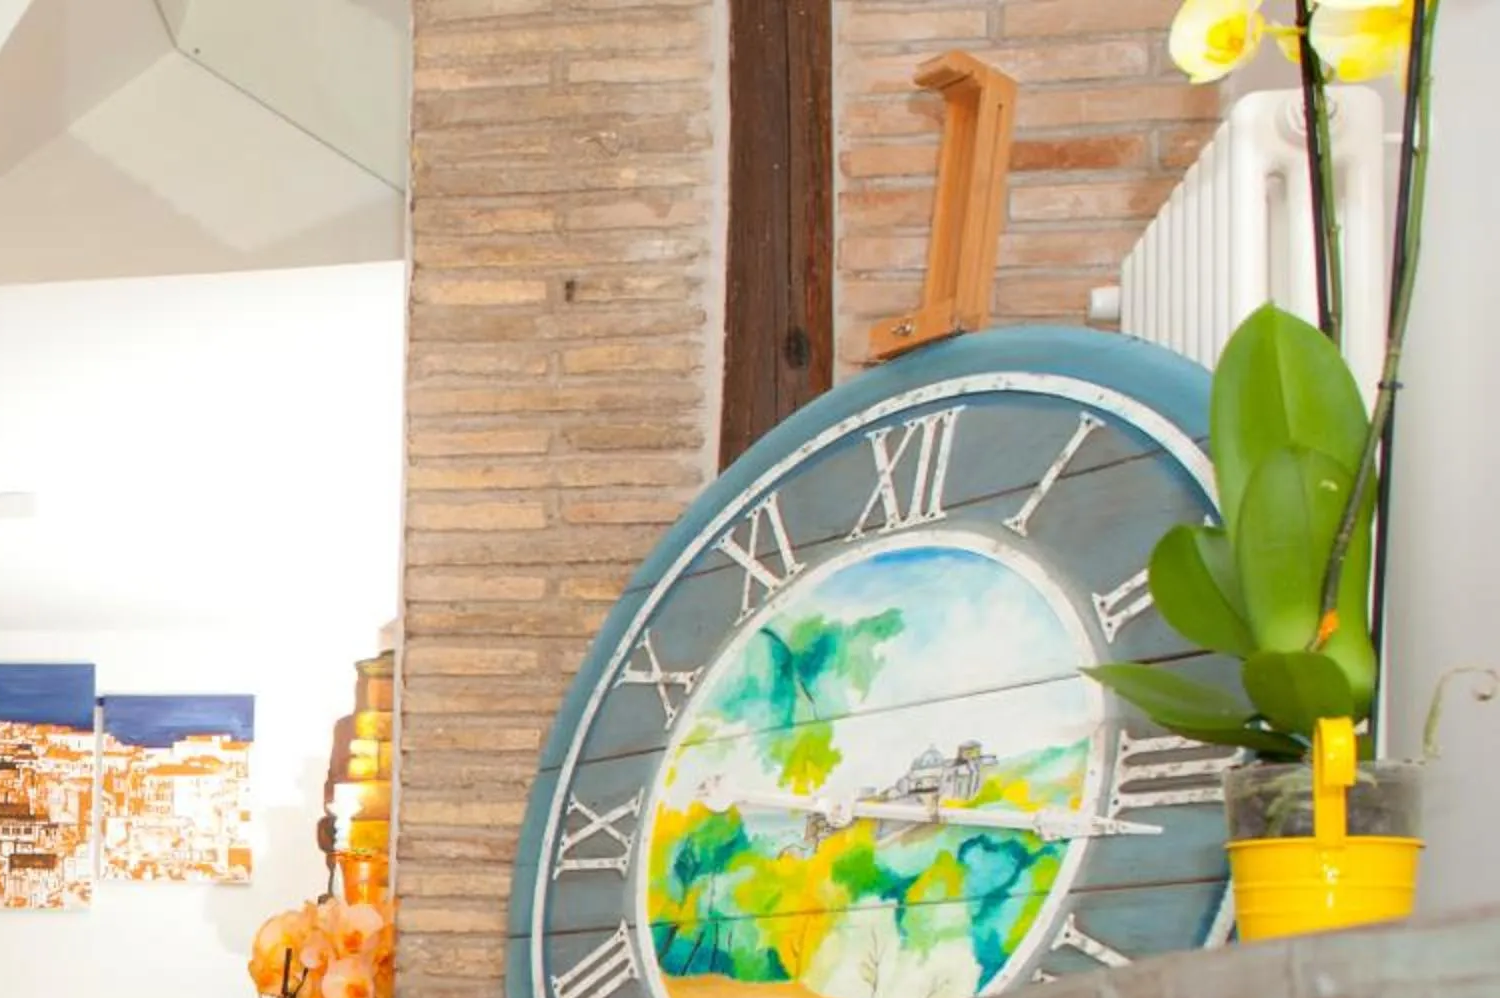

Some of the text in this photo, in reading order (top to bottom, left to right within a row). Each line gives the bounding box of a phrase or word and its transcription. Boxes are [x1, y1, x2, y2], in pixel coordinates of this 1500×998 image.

[845, 406, 965, 542] XII
[714, 491, 806, 626] XI
[614, 629, 705, 730] X
[554, 787, 647, 881] IX
